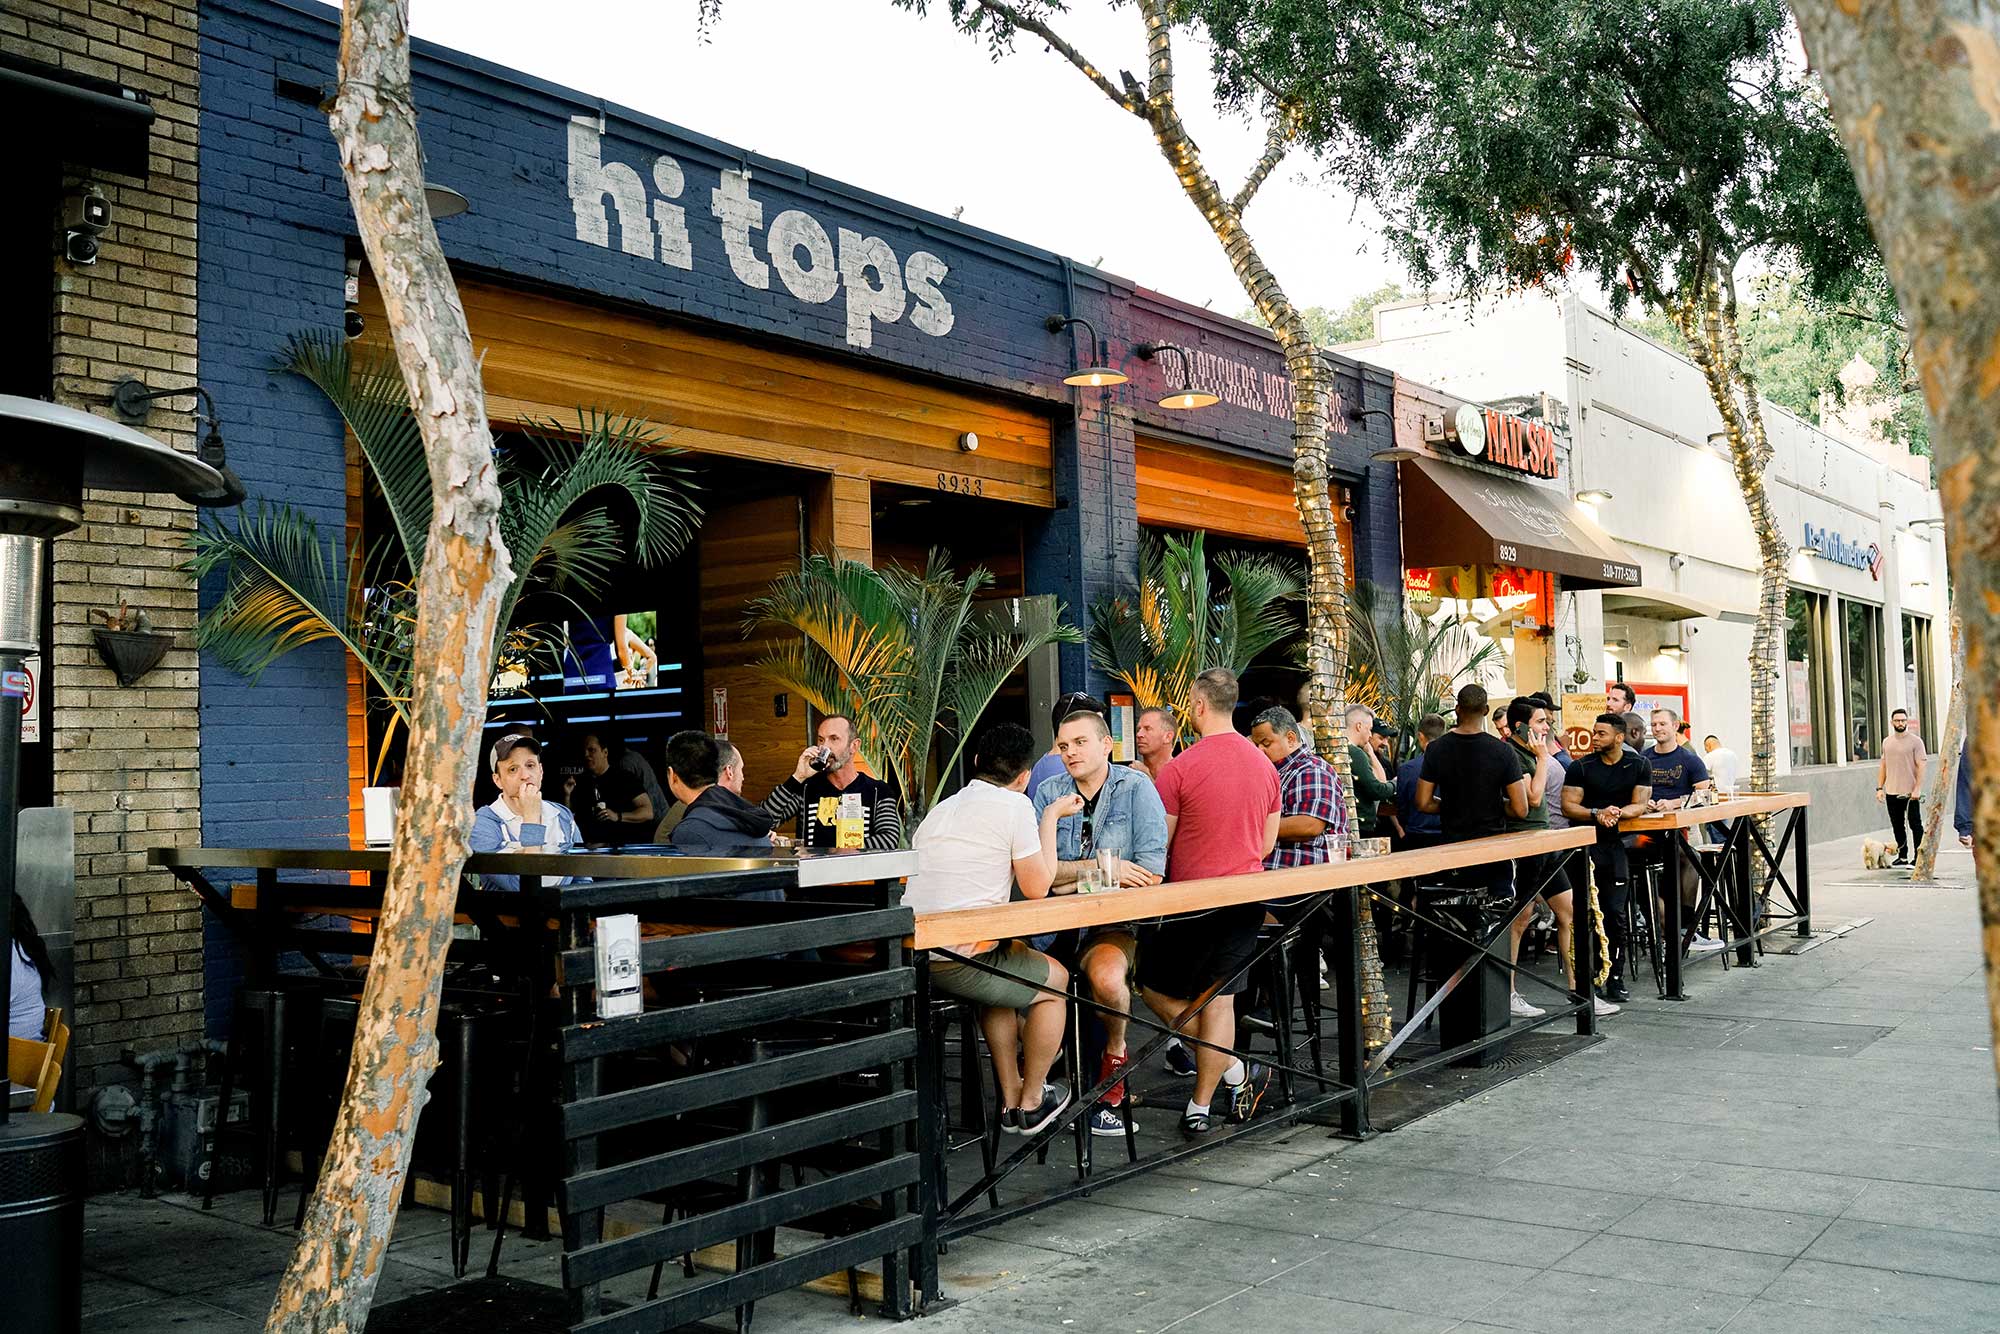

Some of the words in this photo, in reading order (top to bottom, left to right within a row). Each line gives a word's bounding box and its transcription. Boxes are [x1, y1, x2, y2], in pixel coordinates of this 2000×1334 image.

[567, 115, 692, 270] hi
[711, 168, 954, 348] tops
[1196, 350, 1263, 412] PITCHERS
[1263, 371, 1291, 420] HOT
[1485, 408, 1528, 471] NAIL
[1527, 419, 1558, 479] SPA
[938, 473, 981, 497] 8933
[1500, 545, 1517, 562] 8929
[1406, 588, 1432, 603] AXING
[1568, 730, 1591, 751] 10
